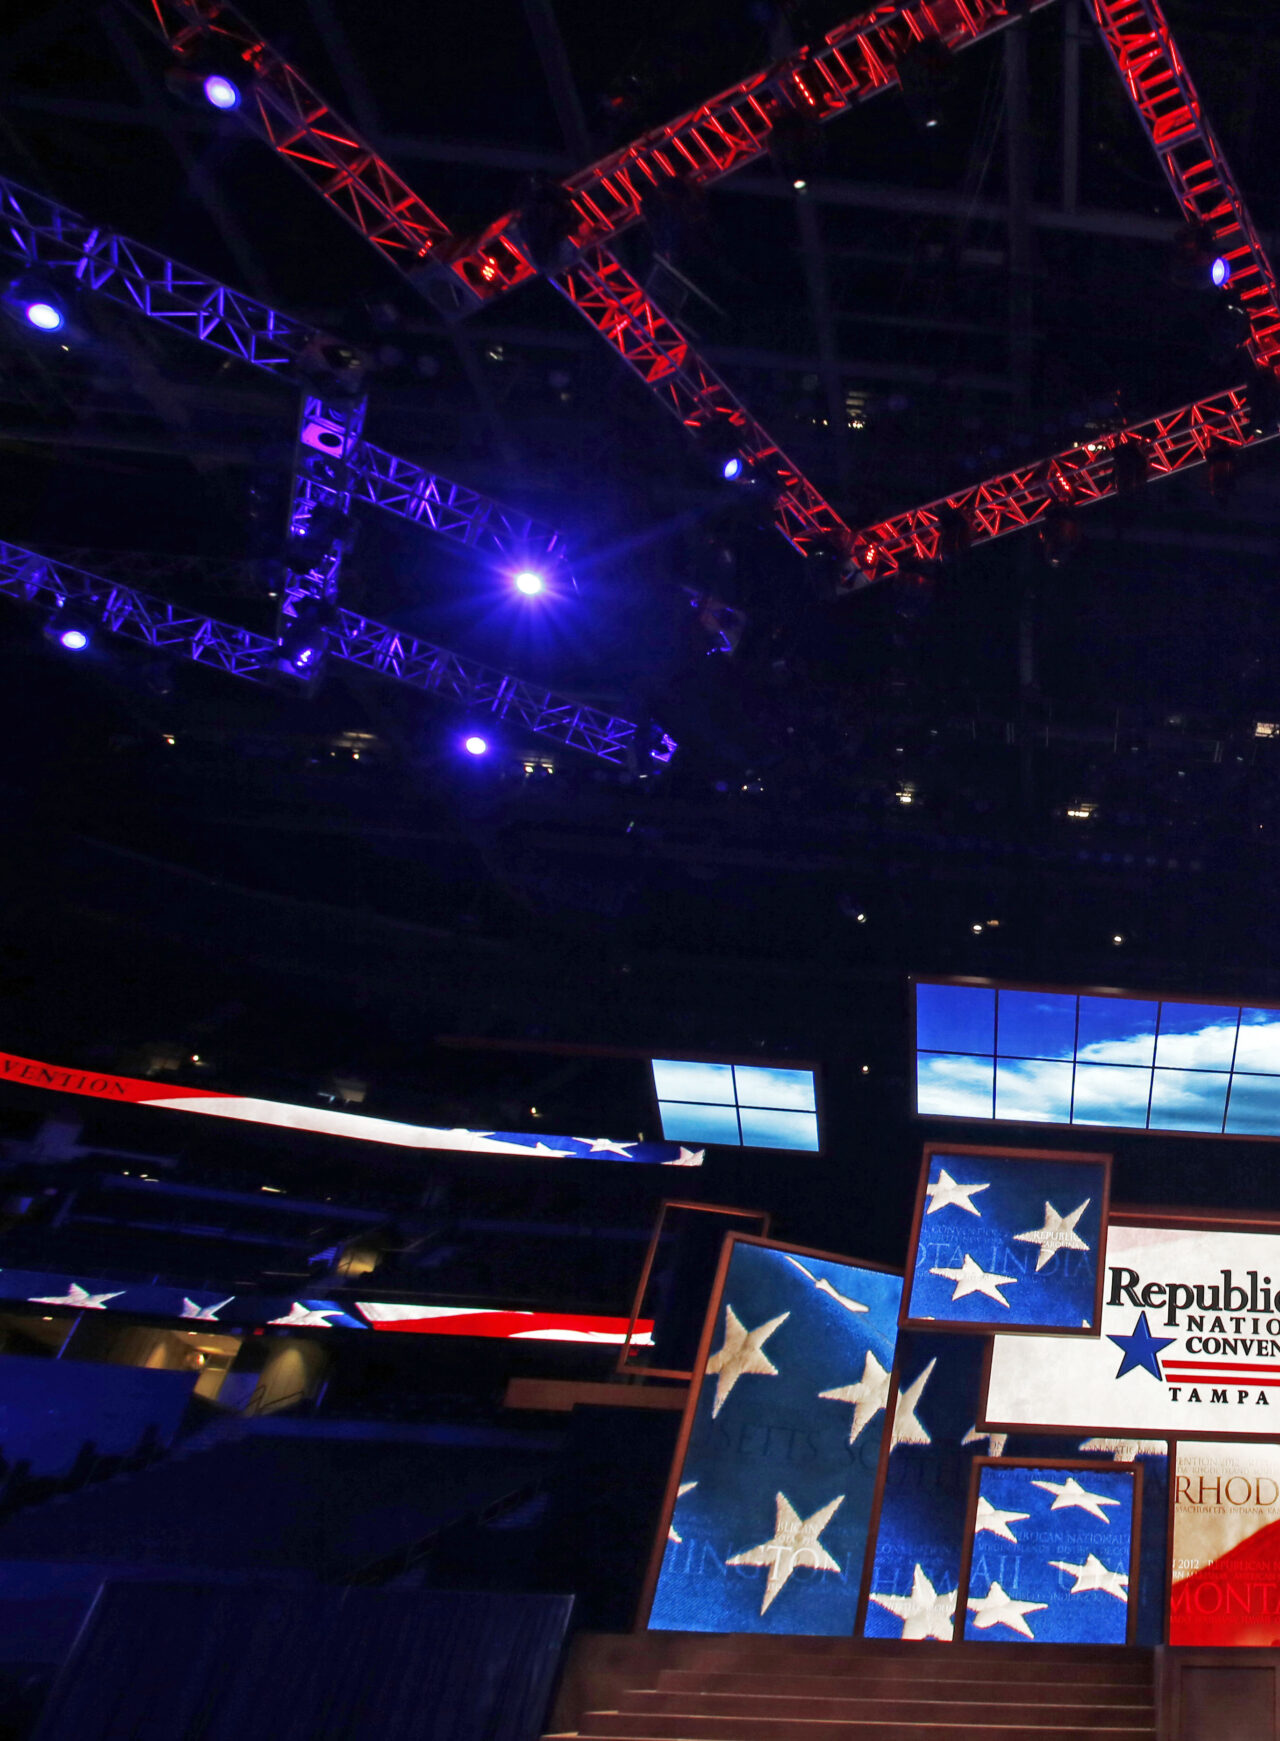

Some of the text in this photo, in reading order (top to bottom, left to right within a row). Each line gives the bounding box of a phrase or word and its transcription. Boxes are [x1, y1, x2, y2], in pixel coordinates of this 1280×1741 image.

[1, 1059, 129, 1096] VENTION
[1168, 1386, 1270, 1406] TAMPA
[1178, 1559, 1200, 1569] 2012
